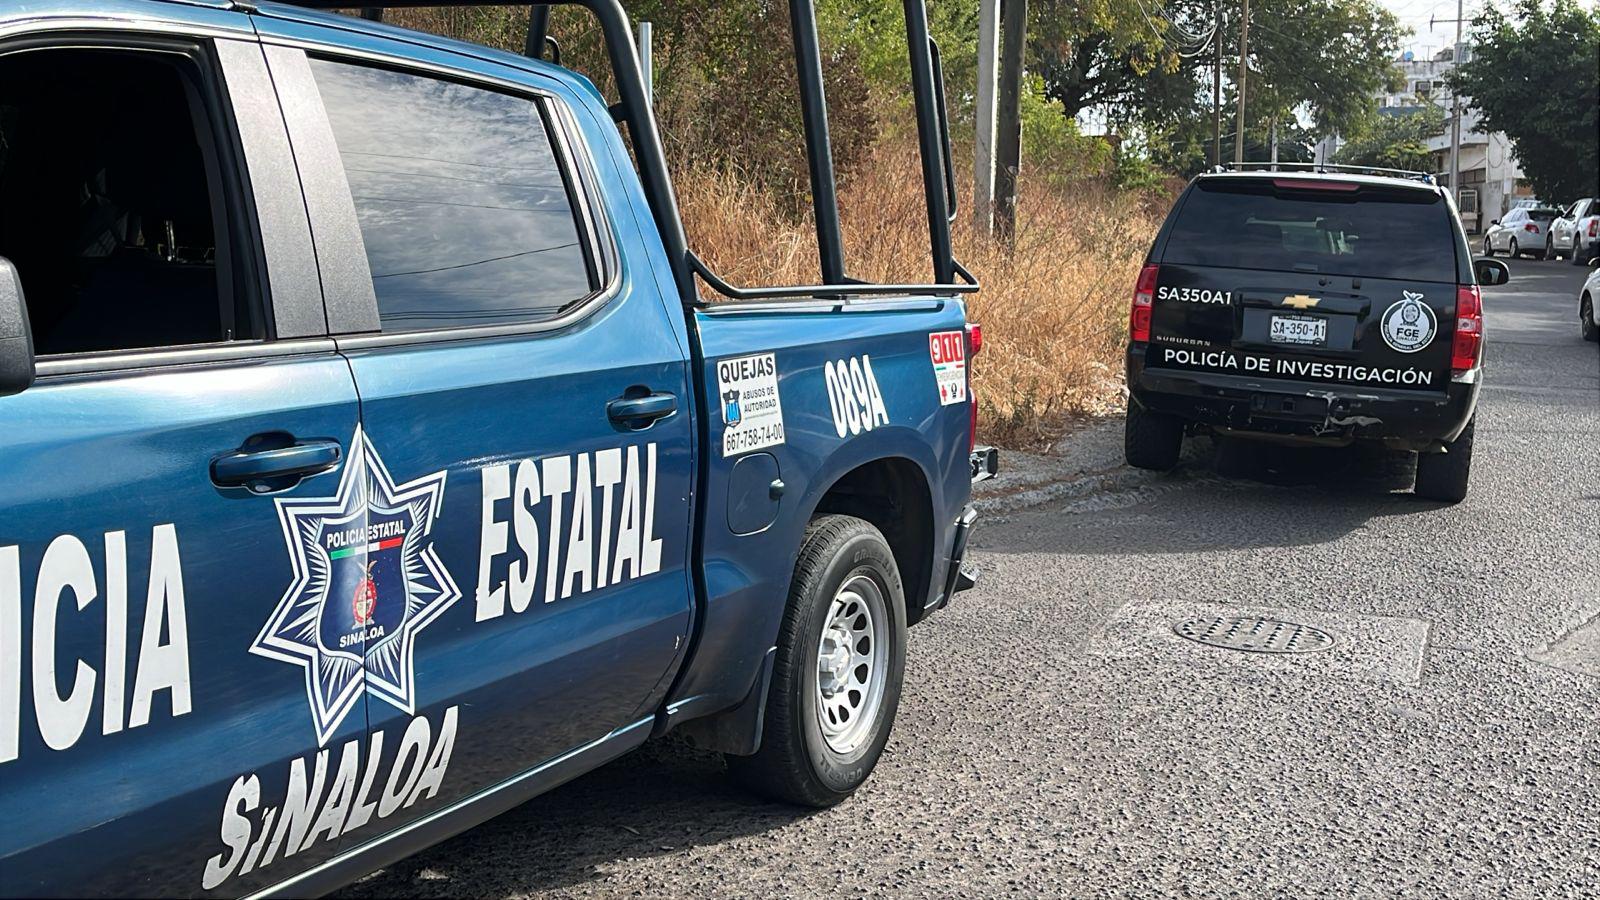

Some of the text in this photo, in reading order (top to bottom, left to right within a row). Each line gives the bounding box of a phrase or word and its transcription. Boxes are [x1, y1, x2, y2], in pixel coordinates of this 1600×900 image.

[1157, 286, 1232, 305] SA350A1
[1156, 335, 1211, 347] SUBURBAN
[1272, 321, 1325, 337] SA-350-A1
[1396, 327, 1420, 338] FGE
[932, 336, 962, 361] 911
[720, 356, 774, 384] QUEJAS
[1164, 348, 1433, 385] POLICÍA DE INVESTIGACIÓN
[742, 386, 775, 400] ABUSOS DE
[824, 354, 890, 439] 089A
[743, 398, 777, 413] AUTORIDAD
[726, 423, 783, 452] 667-758-74-00
[326, 519, 406, 549] POLICIA ESTATAL
[475, 442, 663, 623] ESTATAL
[339, 625, 385, 648] SINALOA
